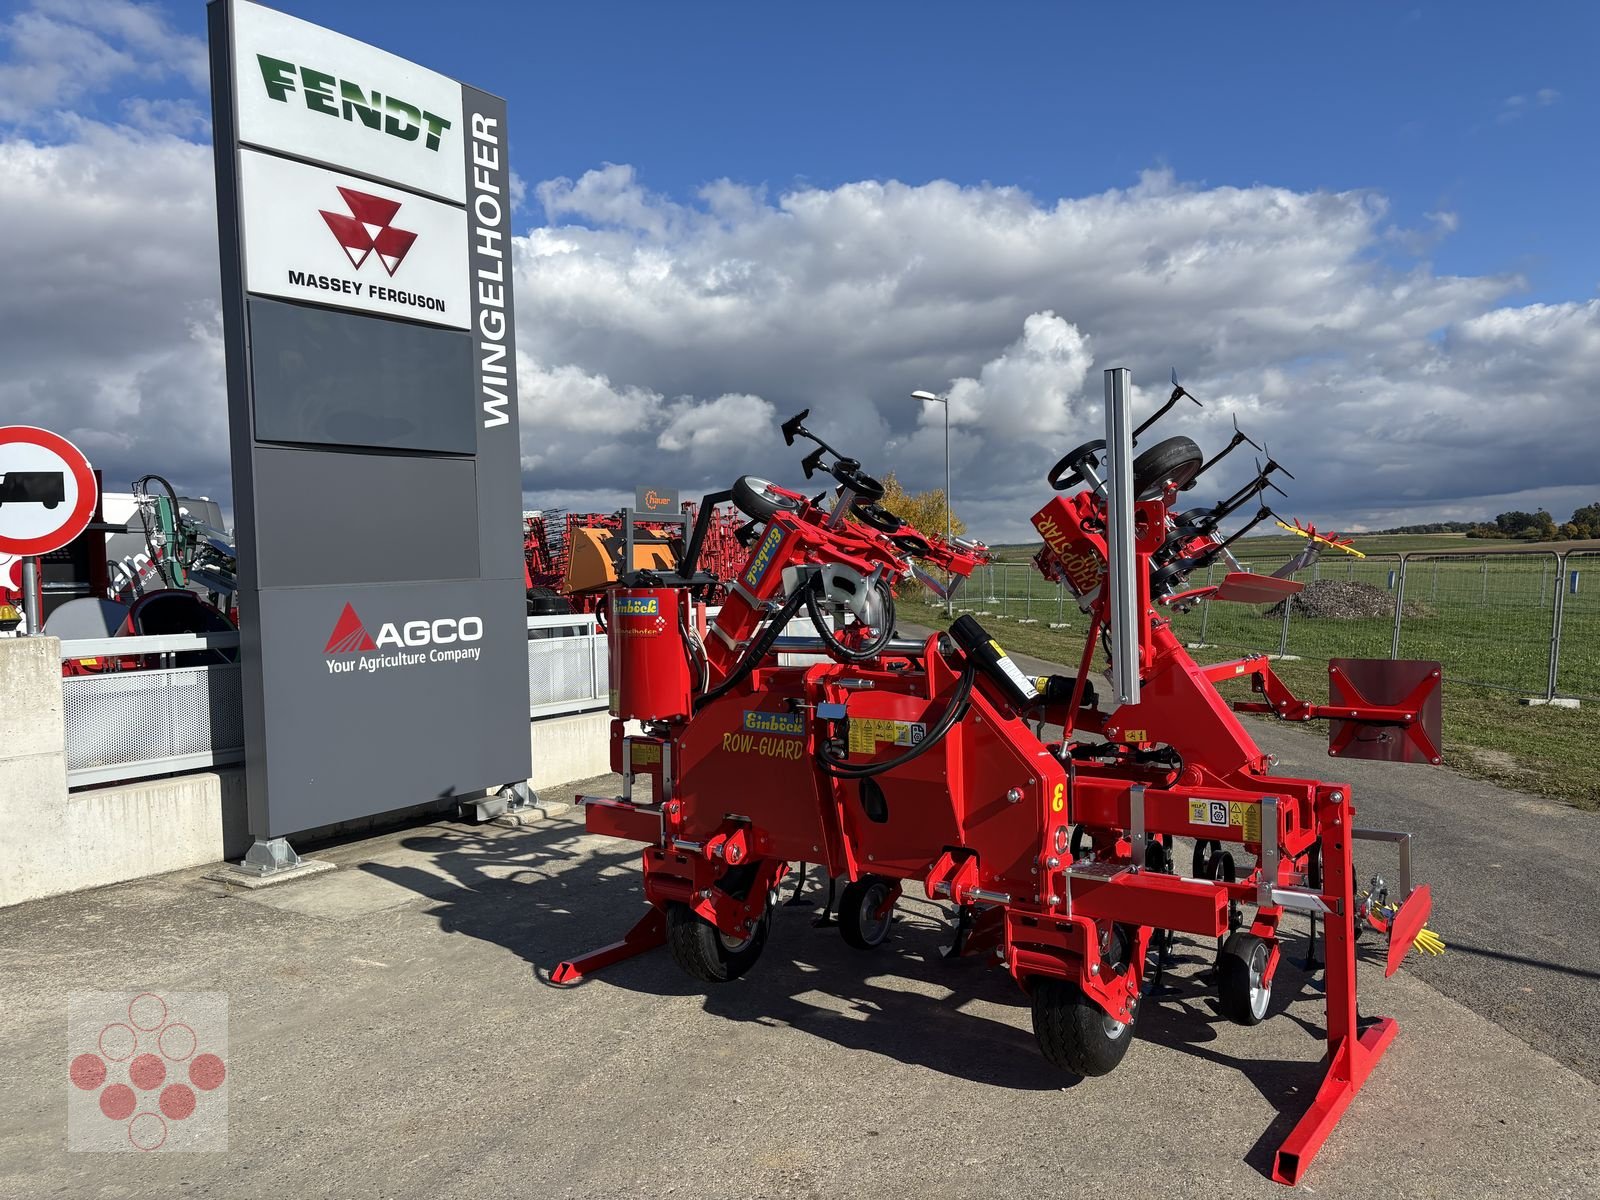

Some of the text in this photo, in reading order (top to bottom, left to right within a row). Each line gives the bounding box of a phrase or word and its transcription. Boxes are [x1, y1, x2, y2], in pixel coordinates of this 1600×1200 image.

[256, 53, 452, 152] FENDT
[471, 112, 510, 429] WINGELHOFER
[288, 270, 446, 312] MASSEY FERGUSON
[650, 495, 671, 505] hauer
[746, 527, 781, 586] Einböck
[375, 616, 484, 650] AGCO
[325, 647, 481, 674] Your Agriculture Company
[745, 712, 803, 733] Einböck
[722, 732, 804, 760] ROW-GUARD
